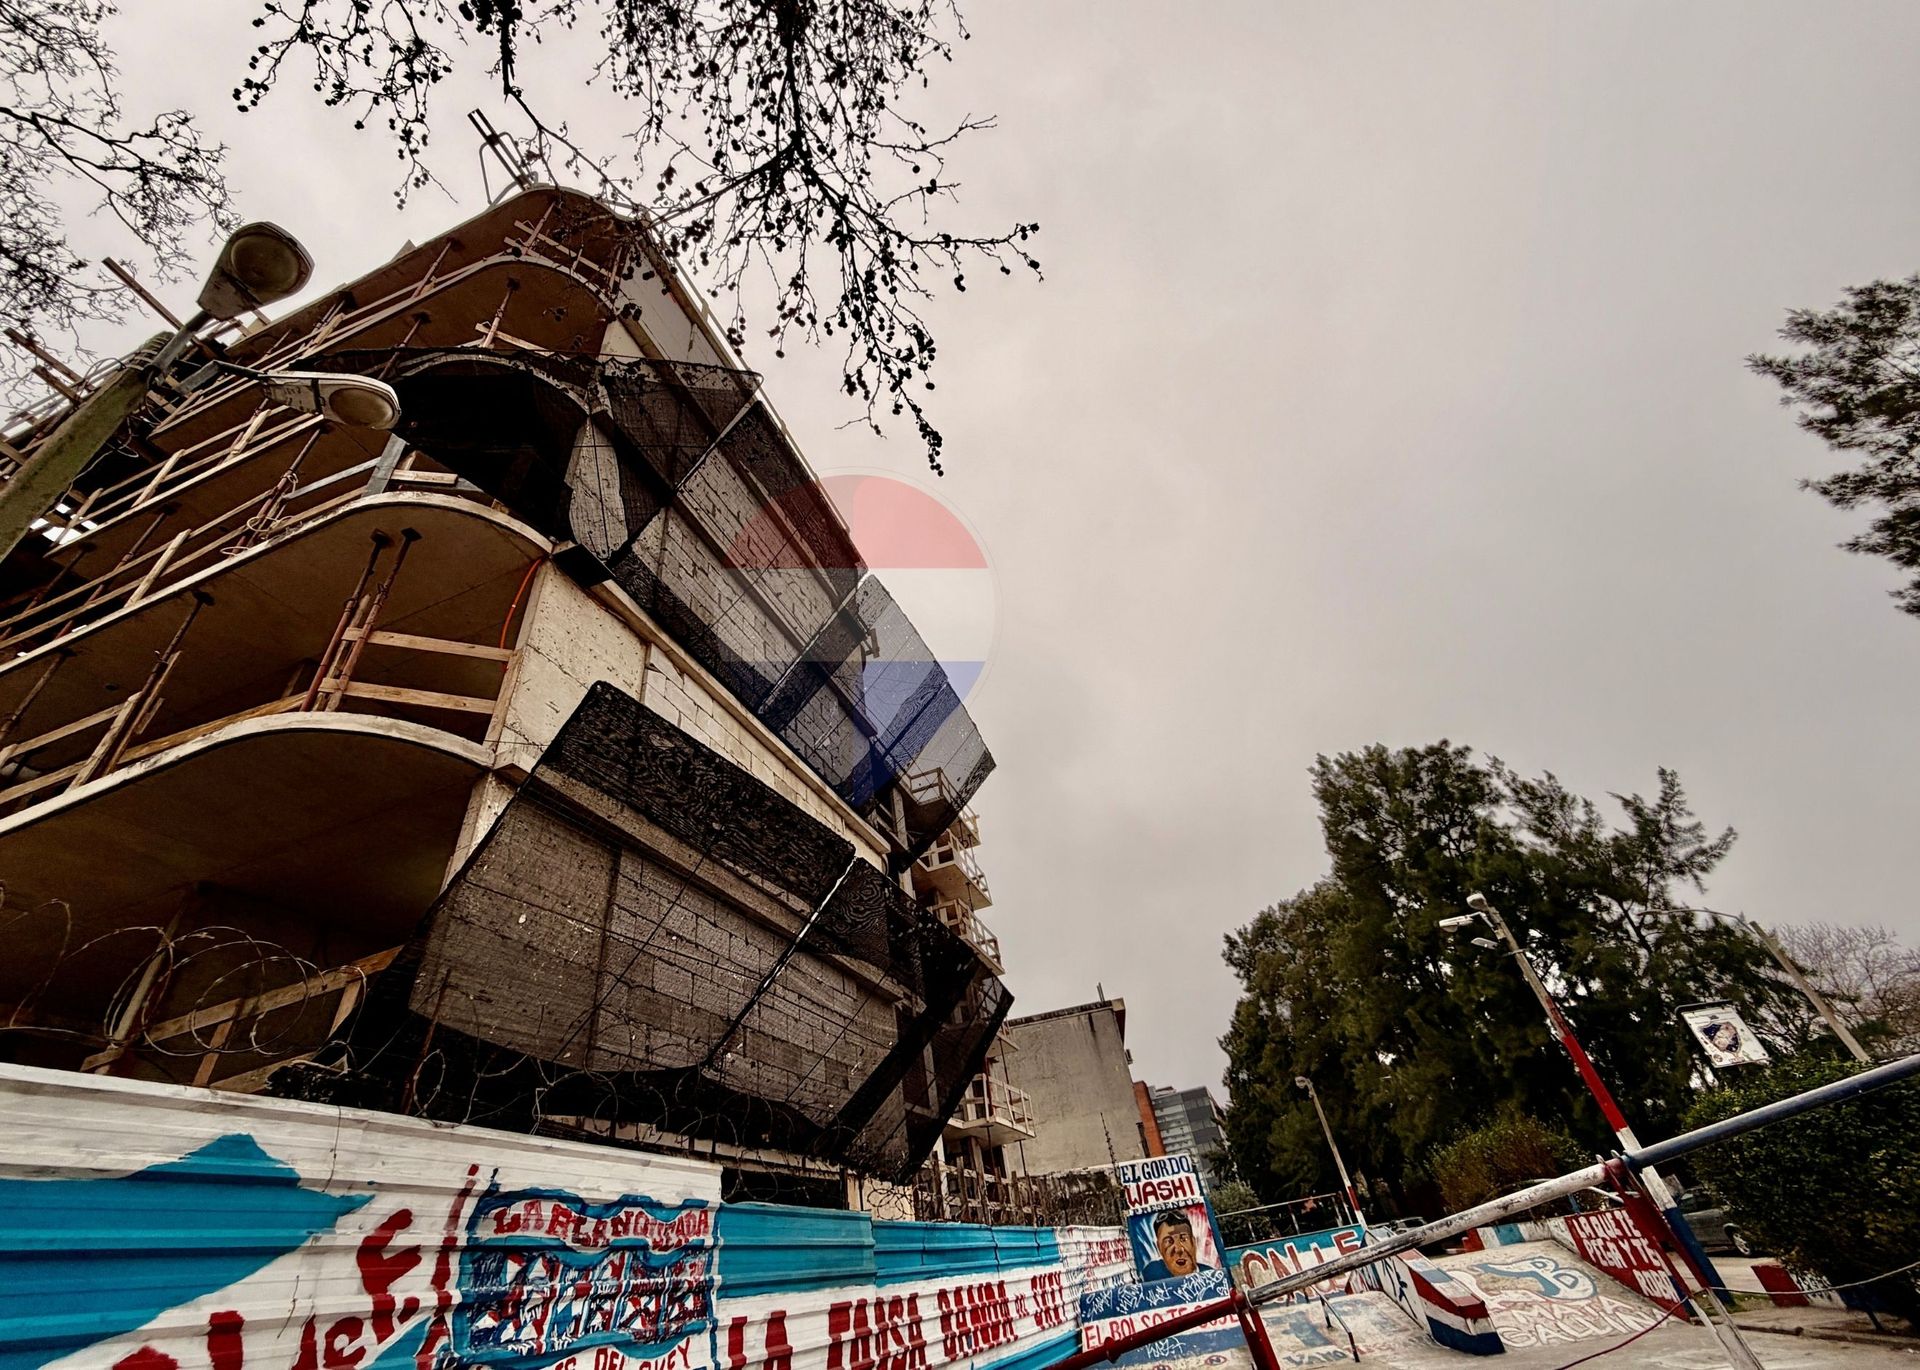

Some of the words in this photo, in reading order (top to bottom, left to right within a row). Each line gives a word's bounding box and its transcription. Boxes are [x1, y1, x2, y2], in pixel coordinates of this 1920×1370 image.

[1120, 1163, 1141, 1183] EL
[1141, 1155, 1193, 1181] GORDO
[1123, 1175, 1195, 1208] WASHI
[1571, 1215, 1595, 1239] LA
[1588, 1211, 1624, 1241] QUE
[1613, 1209, 1642, 1238] TE
[1582, 1239, 1628, 1269] PEGA
[1617, 1238, 1637, 1266] Y
[1633, 1269, 1681, 1303] ROBA
[1084, 1324, 1105, 1350] EL
